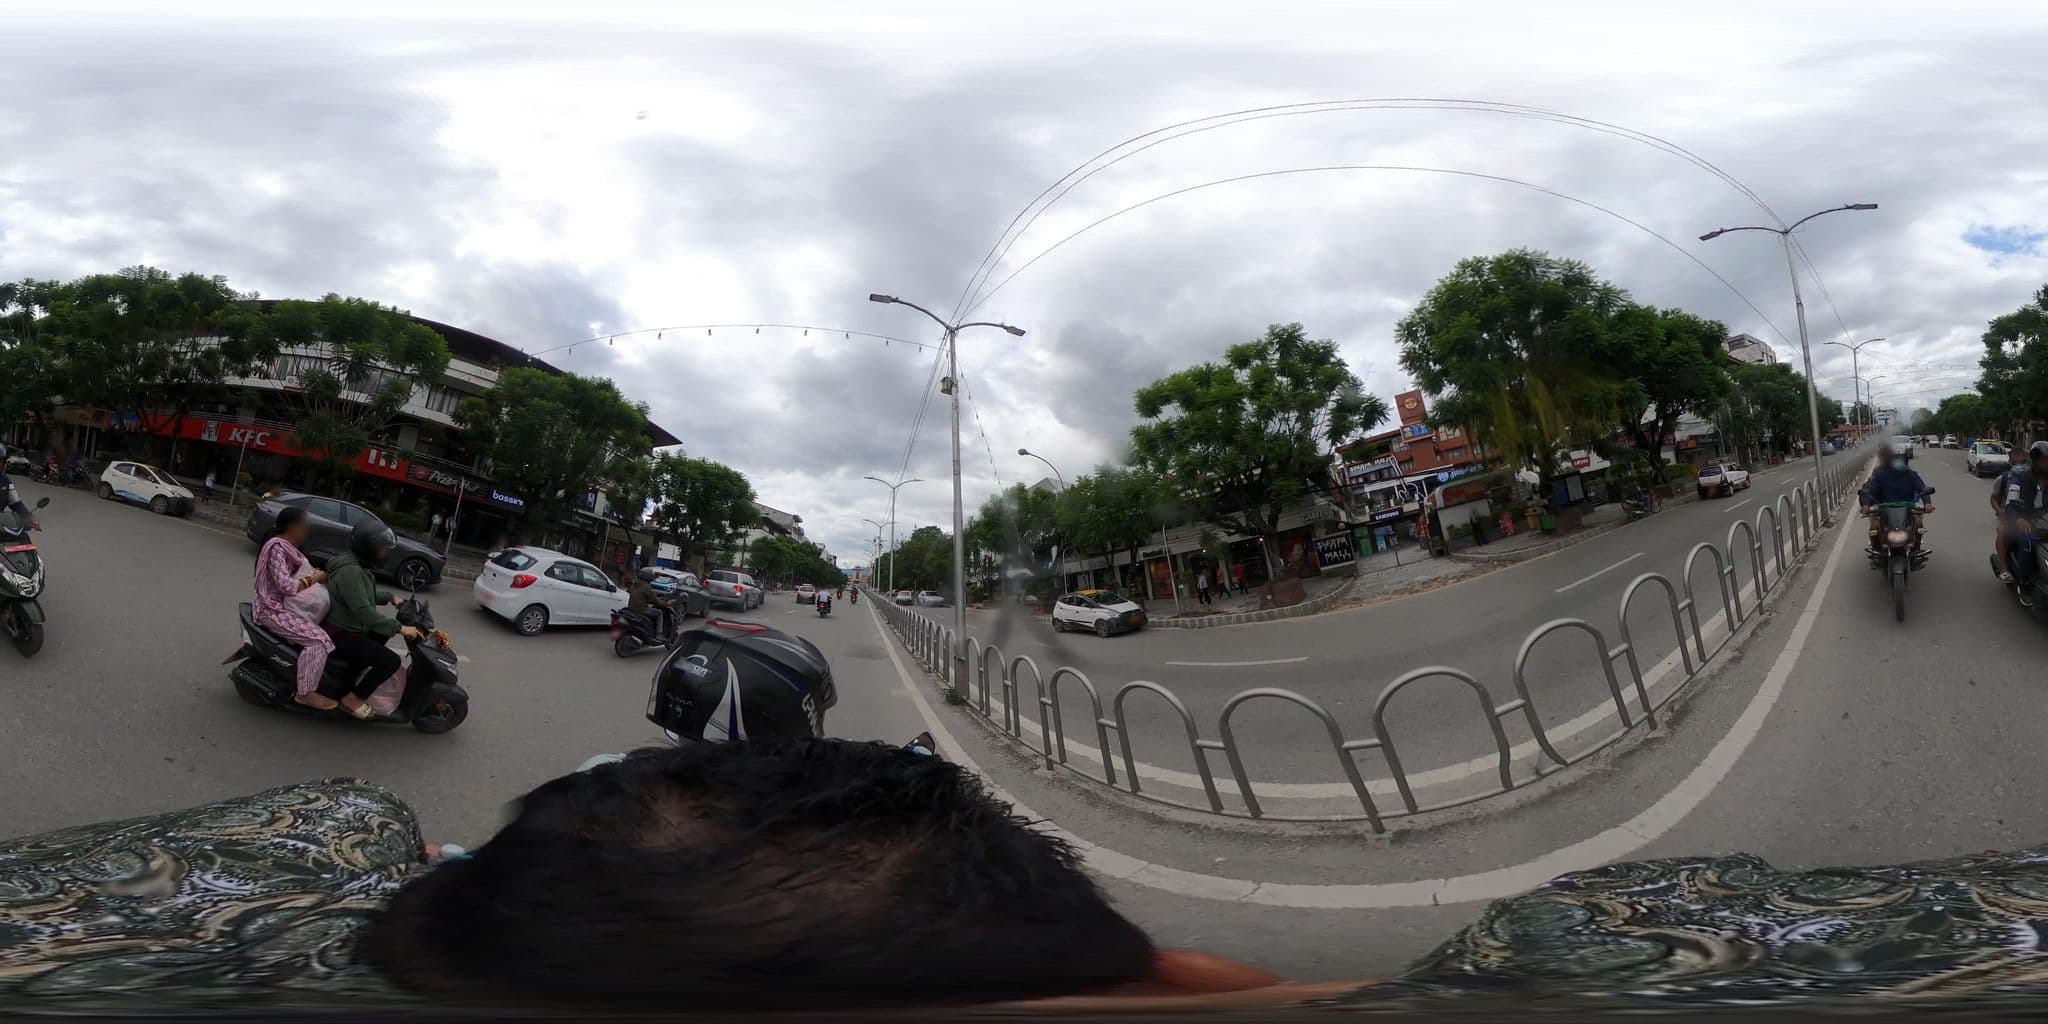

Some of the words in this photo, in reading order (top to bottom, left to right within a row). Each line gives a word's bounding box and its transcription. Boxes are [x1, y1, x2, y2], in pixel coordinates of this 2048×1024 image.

[228, 428, 270, 446] KFC
[429, 471, 458, 490] Pizza
[492, 490, 524, 507] bossini
[1375, 511, 1399, 520] SAMSUNG
[1316, 537, 1349, 552] SHERPA
[1325, 550, 1351, 563] MALL
